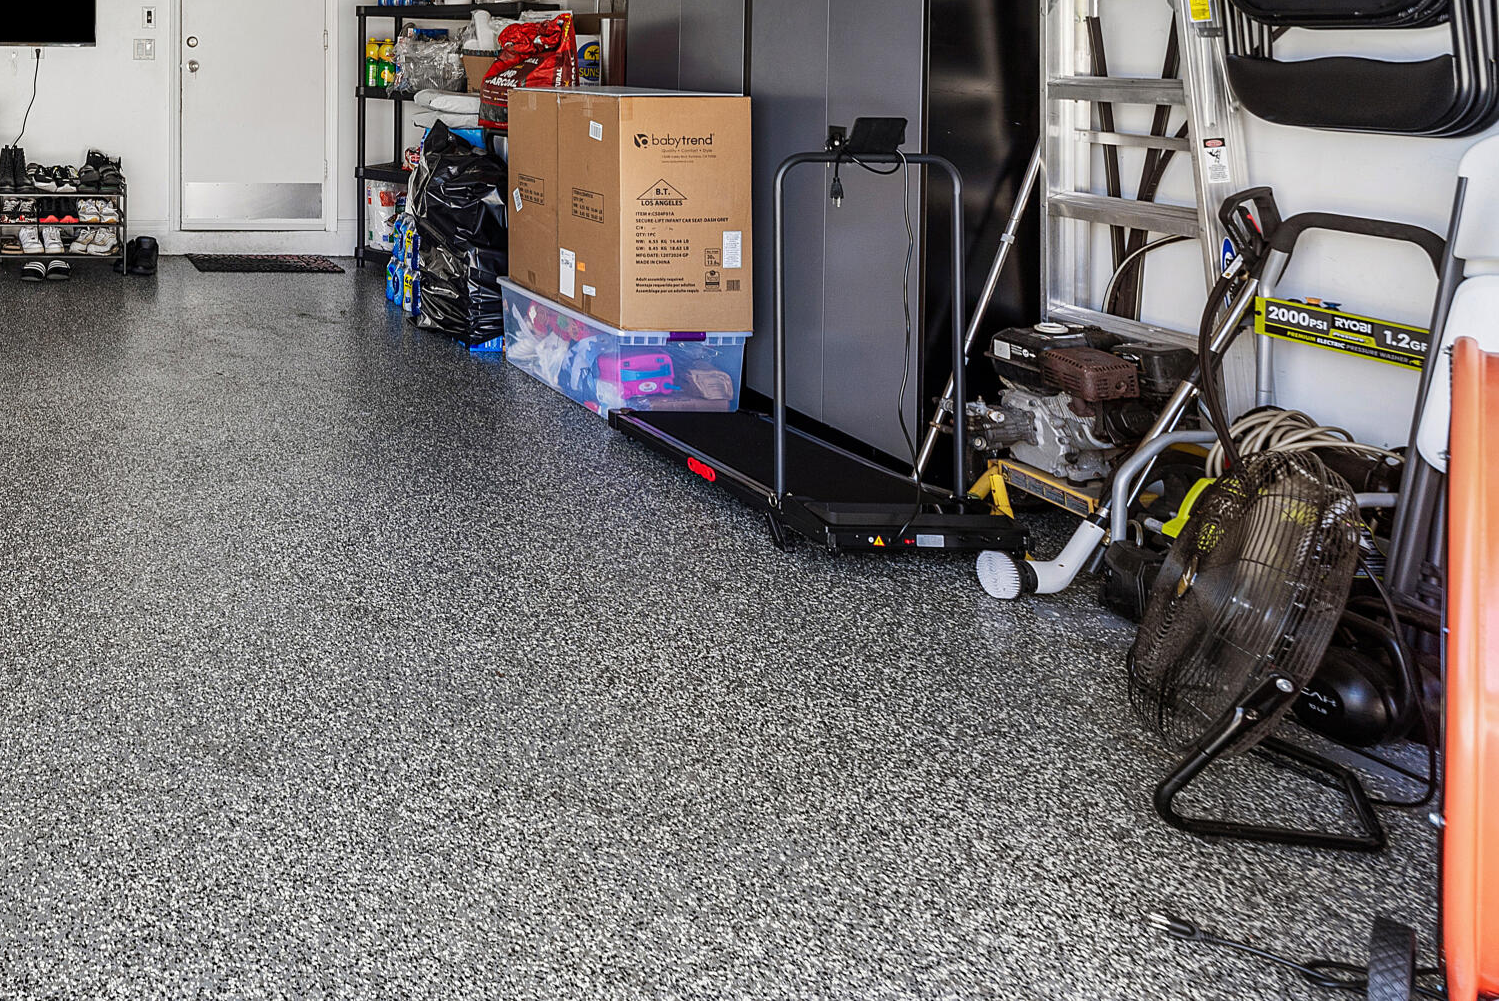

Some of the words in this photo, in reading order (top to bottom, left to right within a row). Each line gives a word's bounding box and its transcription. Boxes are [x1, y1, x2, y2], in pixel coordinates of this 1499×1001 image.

[651, 133, 713, 148] babytrend
[655, 188, 671, 196] B.T.
[1333, 316, 1372, 334] RYOBI
[1287, 331, 1316, 342] PREMIUM
[1317, 337, 1346, 350] ELECTRIC
[1346, 344, 1378, 357] PRESSURE
[1379, 352, 1409, 363] WASHER
